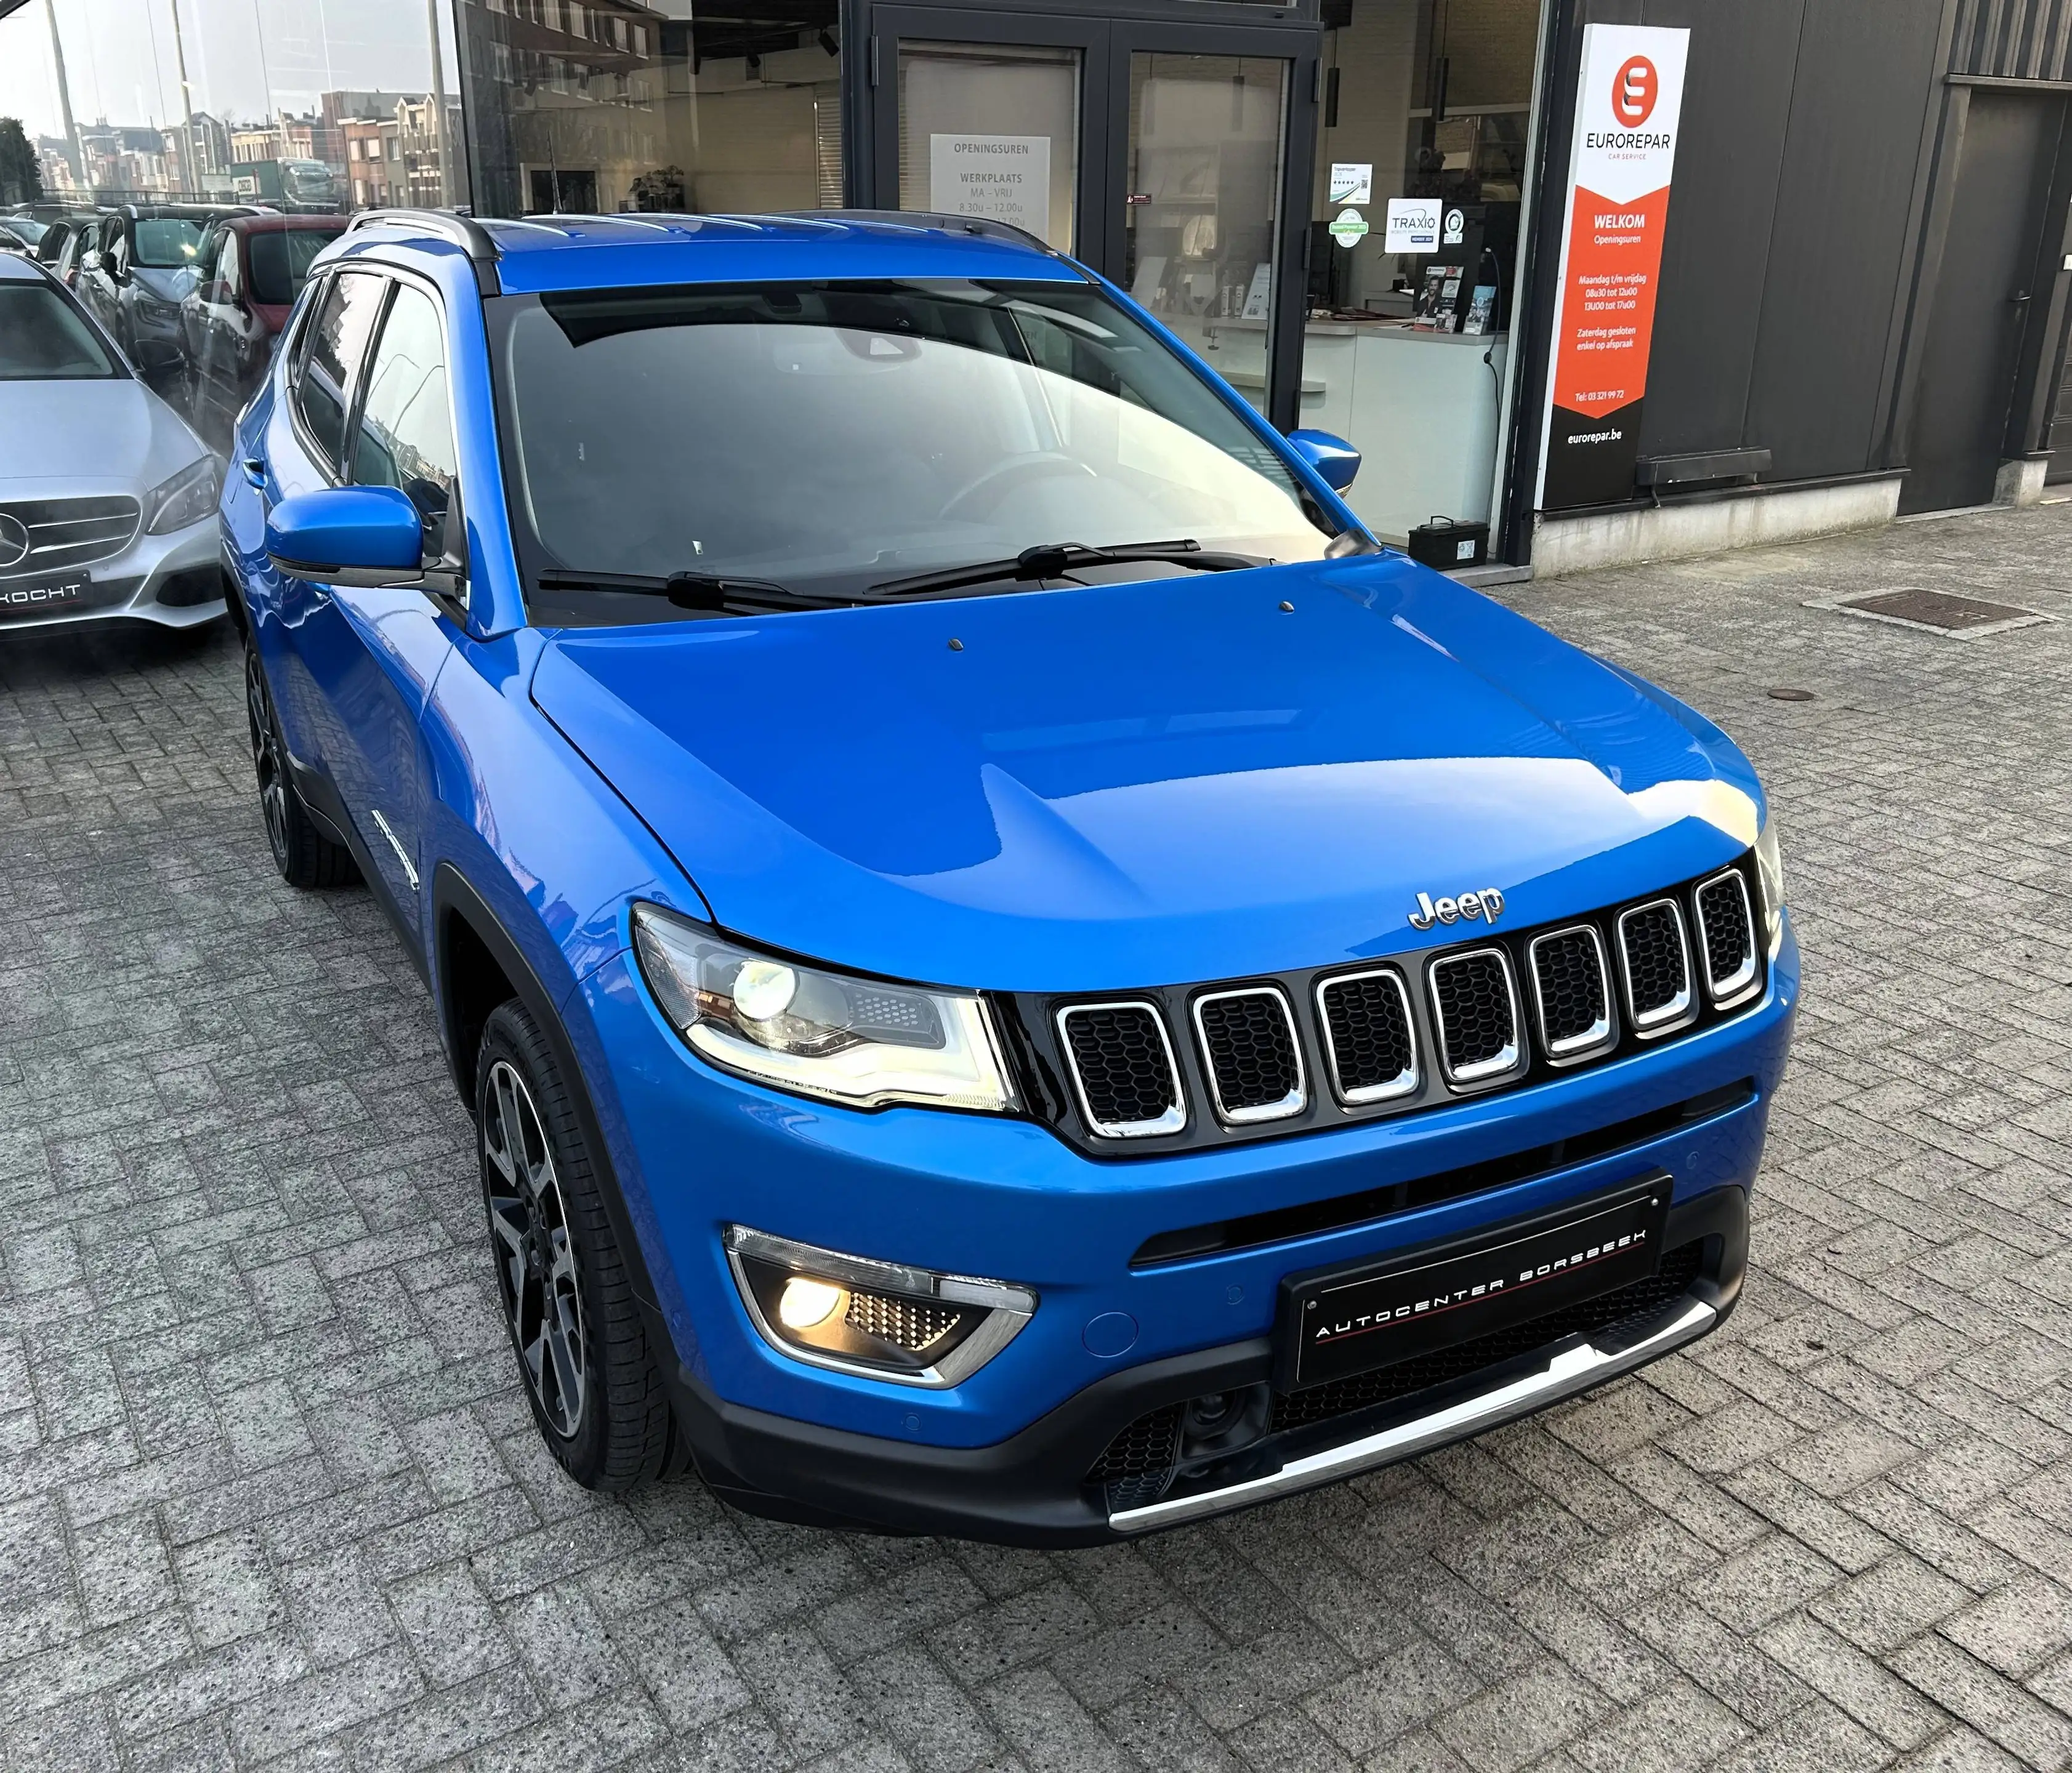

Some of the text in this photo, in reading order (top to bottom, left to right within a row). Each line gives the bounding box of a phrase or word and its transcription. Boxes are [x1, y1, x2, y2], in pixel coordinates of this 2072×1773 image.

[1586, 132, 1671, 149] EUROREPAR
[954, 143, 1029, 154] OPENINGSUREN
[960, 172, 1023, 183] WERKPLAATS
[970, 188, 985, 198] MA
[994, 188, 1013, 198] VRIJ
[959, 203, 984, 212] 8.30u
[994, 203, 1023, 212] 12.00u
[1392, 217, 1436, 229] TRAXIO
[1594, 214, 1645, 229] WELKOM
[1594, 234, 1642, 246] Openingsuren
[1578, 273, 1647, 286] Maandag t/m vrijdag
[1586, 286, 1639, 298] 08u30 tot 12u00
[1605, 302, 1616, 310] tot
[1617, 299, 1636, 310] 17u00
[1577, 325, 1636, 339] Zaterdag gesloten
[1576, 337, 1634, 351] enkel op afspraak
[1575, 388, 1625, 402] Tel: 03 321 99 72
[1568, 428, 1622, 444] eurorepar.be
[1407, 886, 1506, 931] Jeep
[1315, 1229, 1647, 1338] AUTOCENTER BORSBEEK
